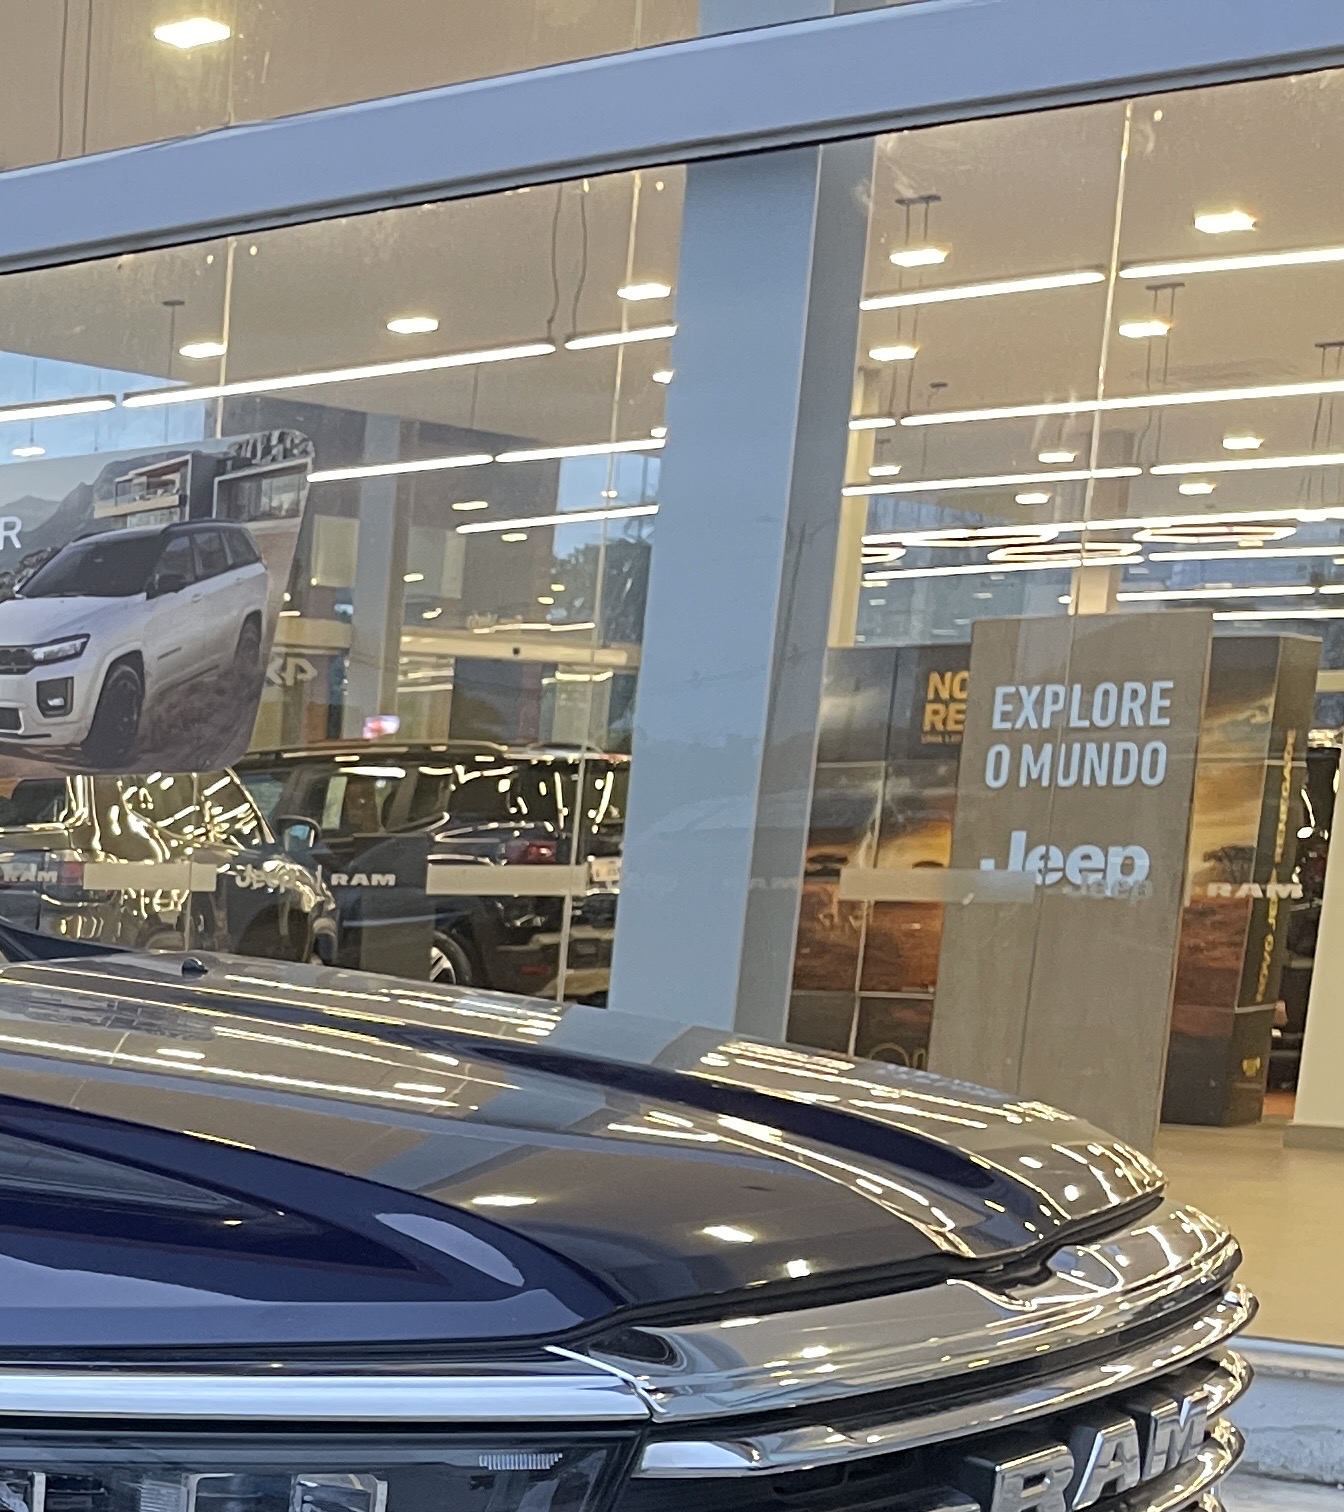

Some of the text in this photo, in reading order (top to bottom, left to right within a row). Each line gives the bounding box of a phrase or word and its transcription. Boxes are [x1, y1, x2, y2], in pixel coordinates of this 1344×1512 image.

[992, 680, 1174, 730] EXPLORE
[985, 740, 1167, 789] O MUNDO
[330, 872, 397, 887] RAM
[979, 830, 1151, 897] Jeep
[1206, 881, 1304, 899] RAM
